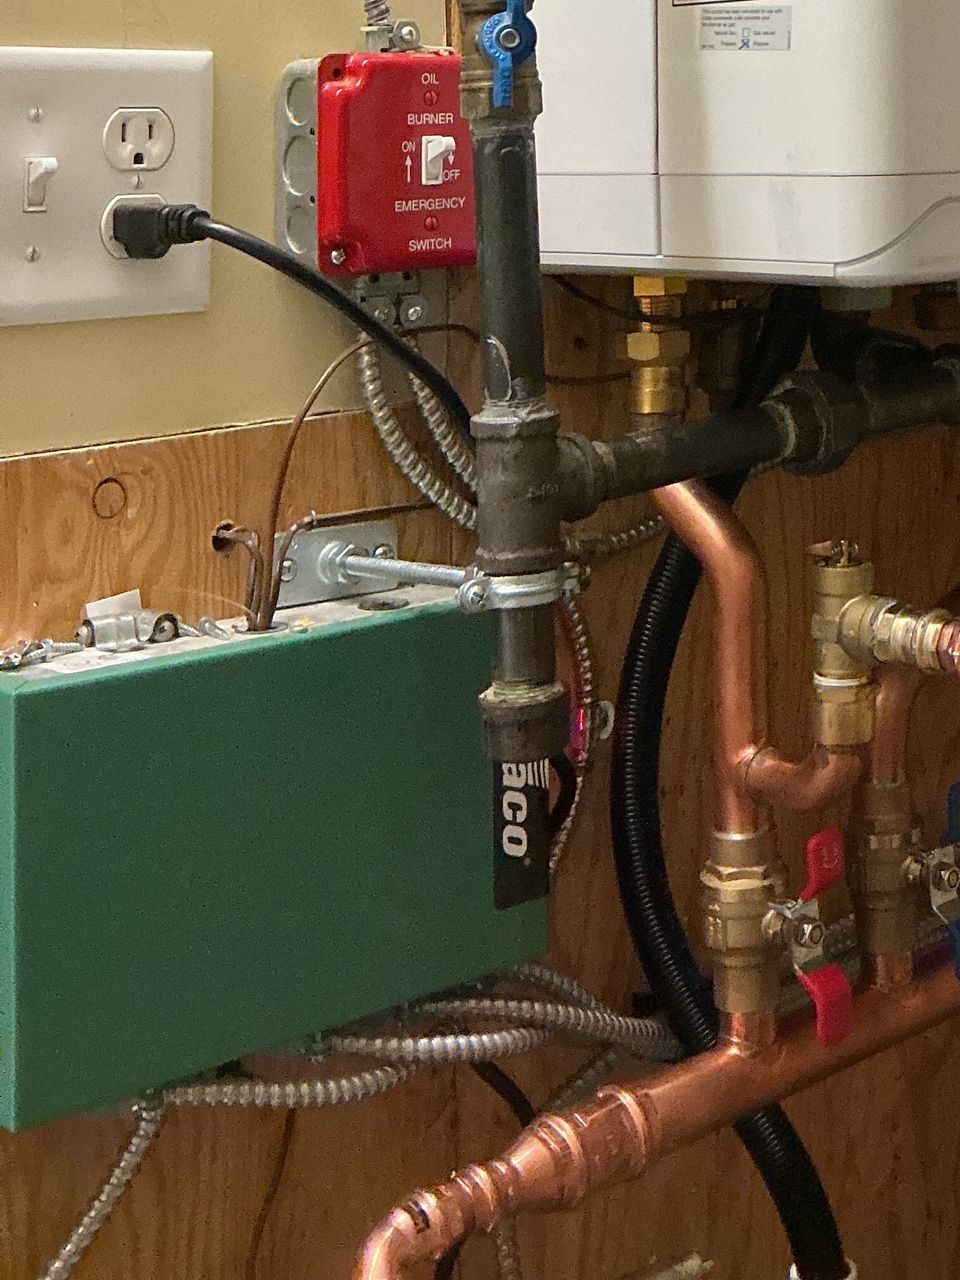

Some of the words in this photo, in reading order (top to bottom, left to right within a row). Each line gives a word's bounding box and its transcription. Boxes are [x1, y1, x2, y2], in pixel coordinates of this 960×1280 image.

[421, 73, 439, 85] OIL
[407, 113, 454, 126] BURNER
[402, 141, 416, 153] ON
[443, 169, 461, 181] OFF
[394, 196, 466, 212] EMERGENCY
[408, 237, 452, 252] SWITCH
